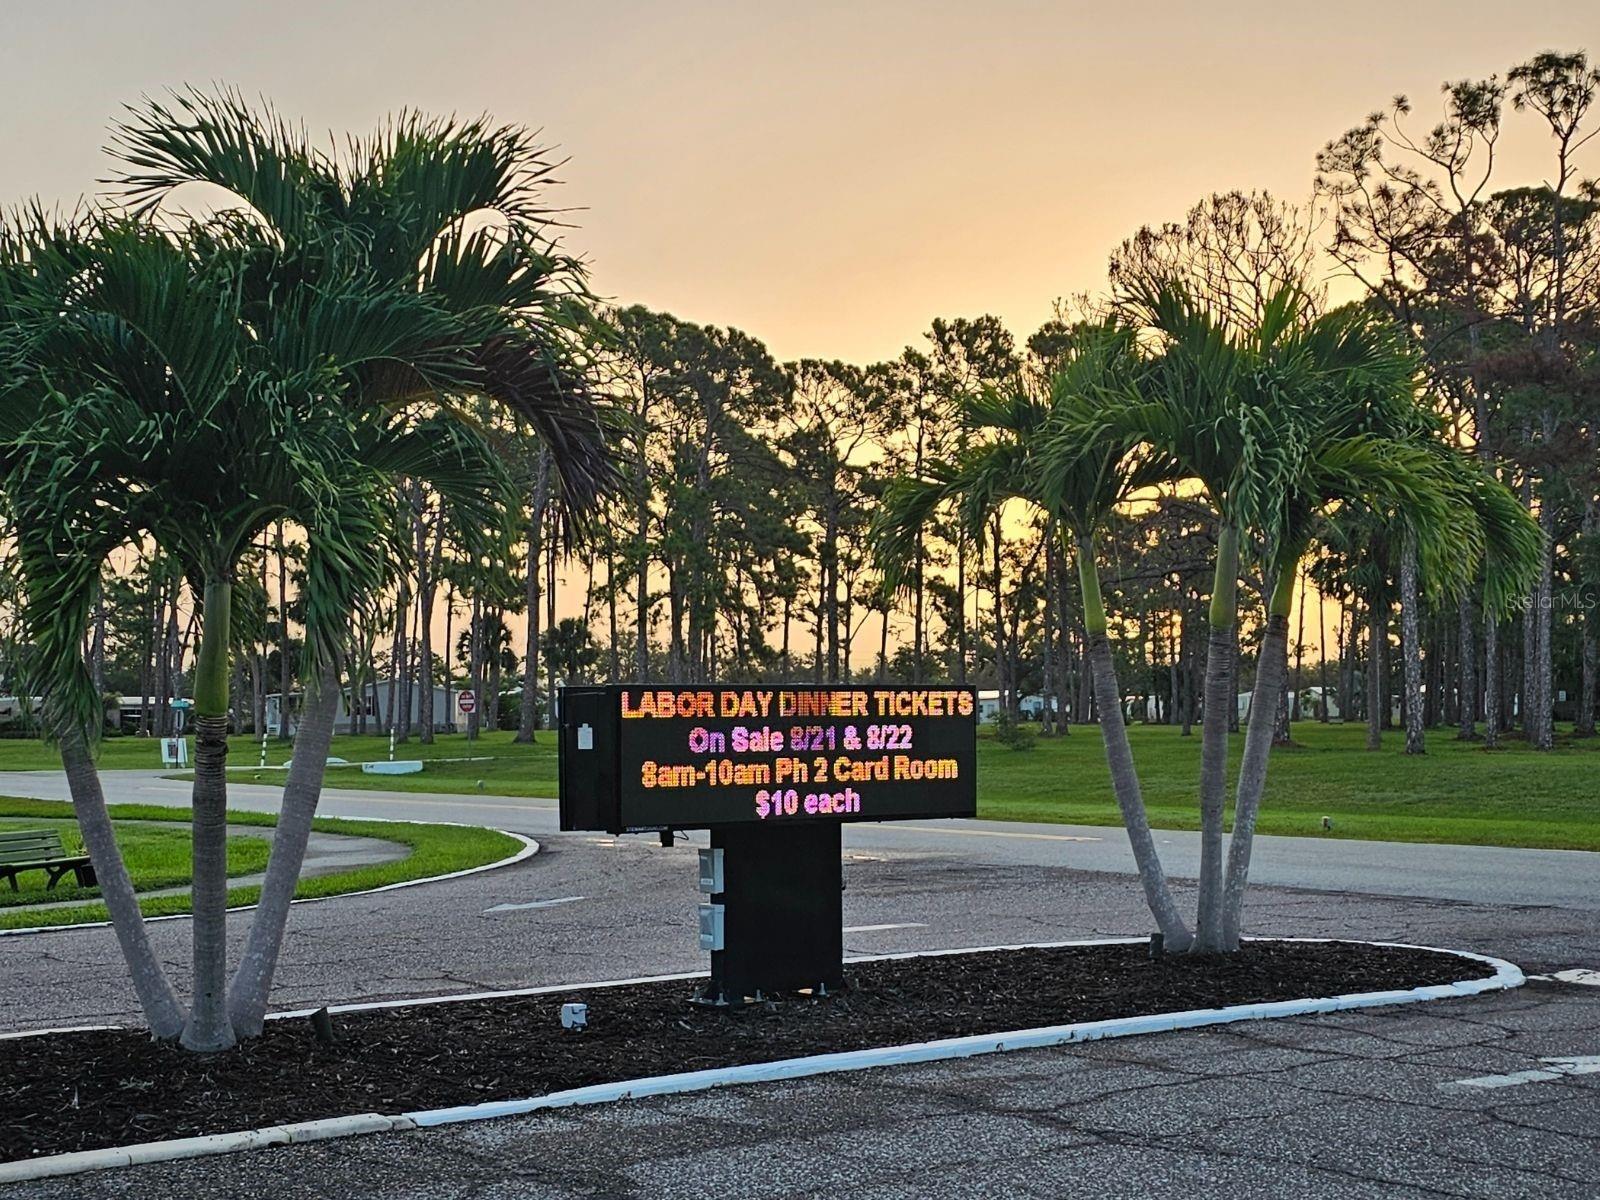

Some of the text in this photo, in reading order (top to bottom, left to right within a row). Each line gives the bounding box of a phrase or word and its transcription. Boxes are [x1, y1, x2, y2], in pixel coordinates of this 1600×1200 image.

[622, 690, 974, 718] LABOR DAY DINNER TICKETS
[689, 724, 912, 753] On Sale 8/21 & 8/22
[641, 755, 959, 788] 8am-10am Ph 2 Card Room
[755, 787, 861, 819] $10 each
